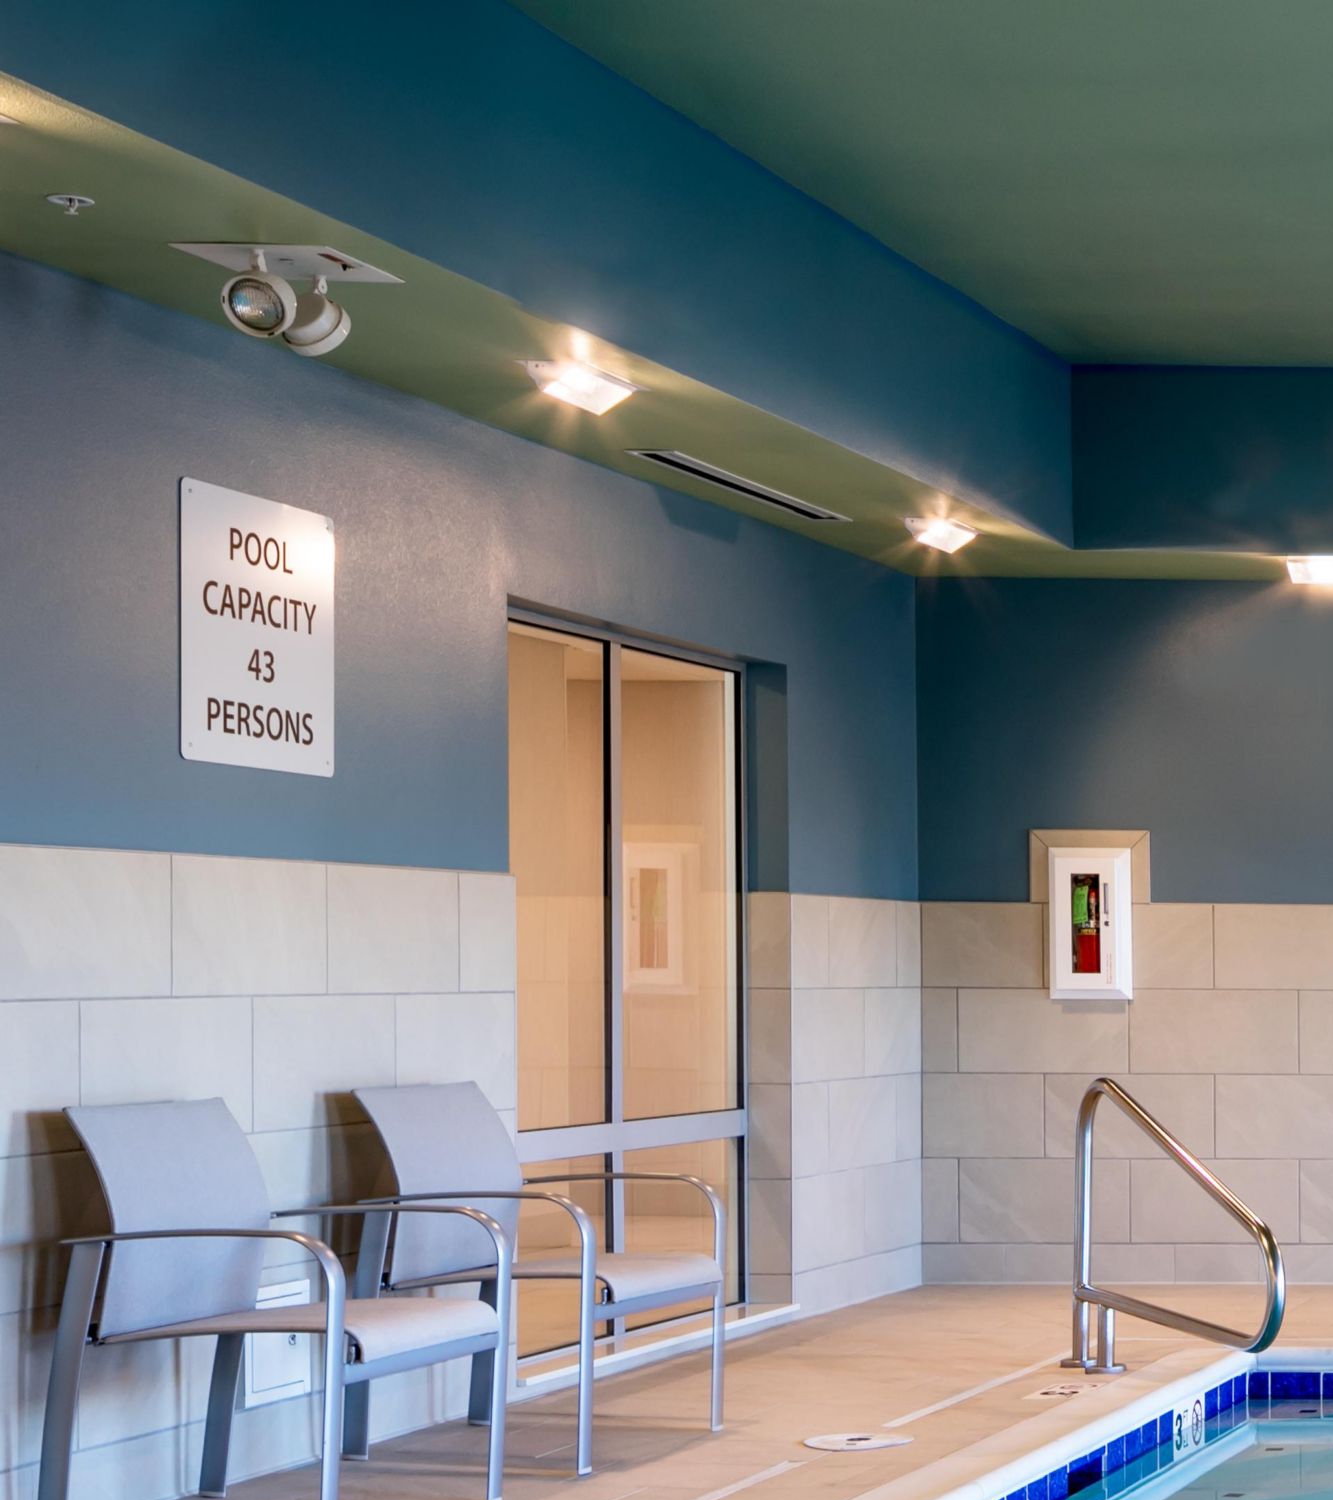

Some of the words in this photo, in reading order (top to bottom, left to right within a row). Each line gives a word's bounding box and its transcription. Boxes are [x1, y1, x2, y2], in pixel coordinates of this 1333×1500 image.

[229, 527, 293, 574] POOL
[203, 580, 317, 635] CAPACITY
[247, 648, 275, 683] 43
[207, 697, 314, 746] PERSONS
